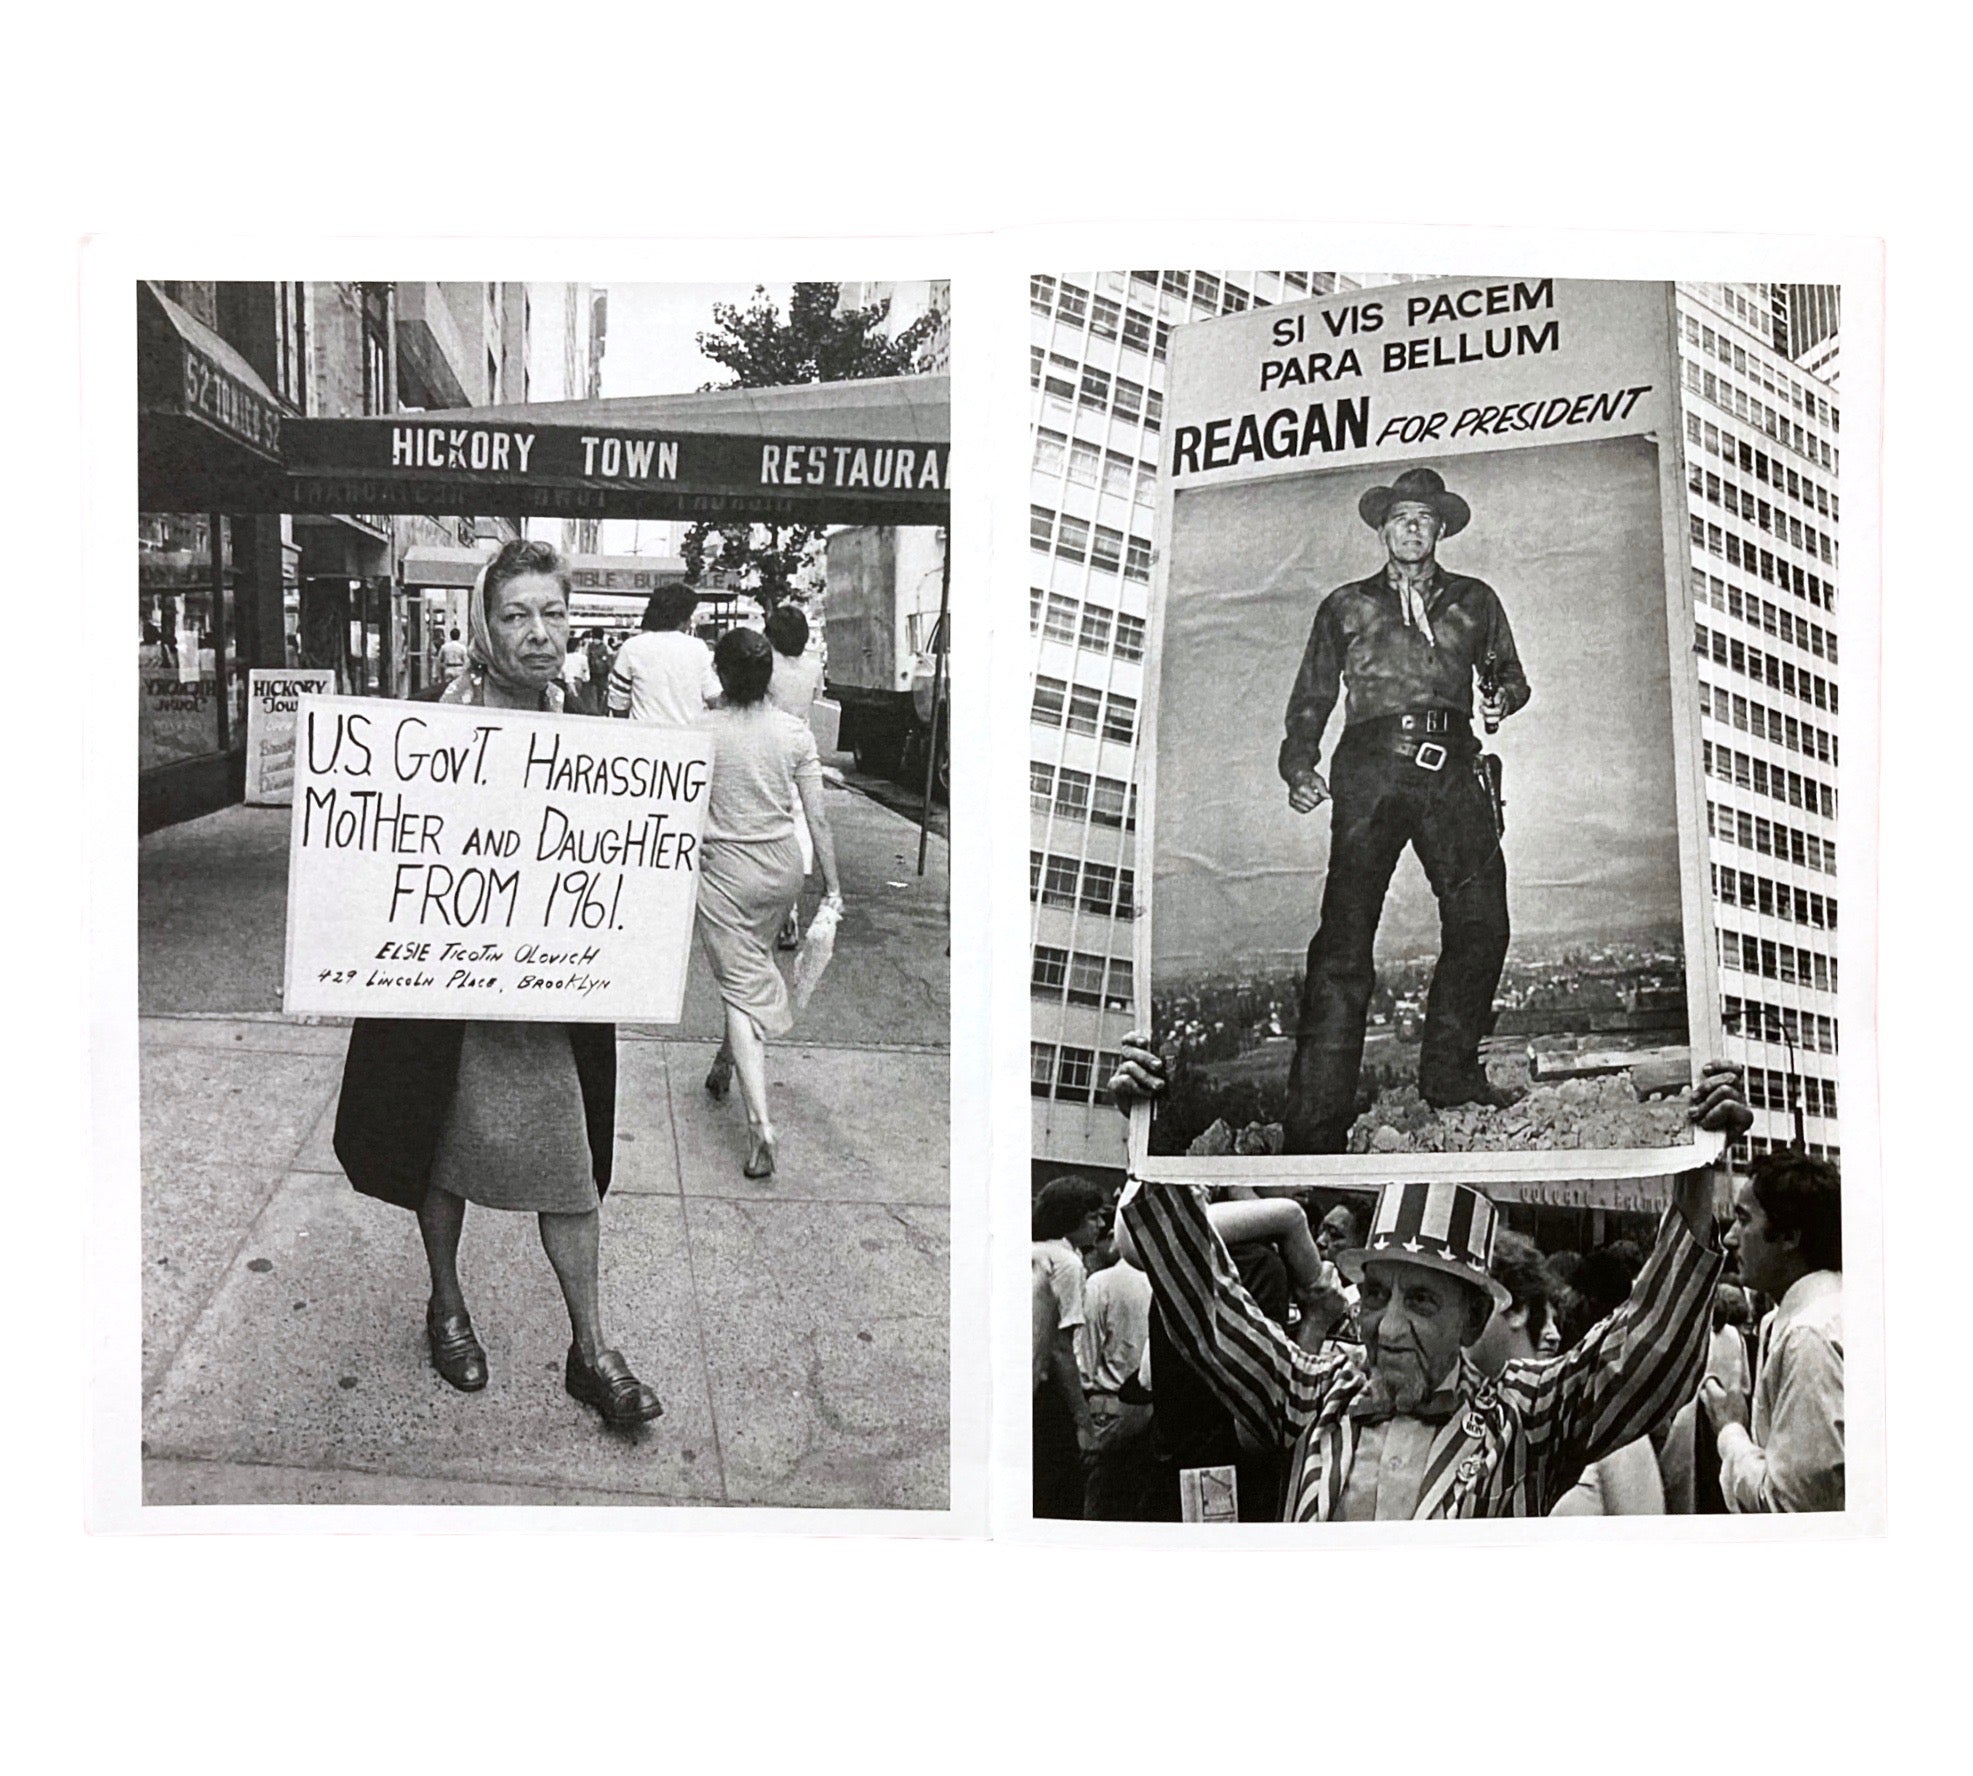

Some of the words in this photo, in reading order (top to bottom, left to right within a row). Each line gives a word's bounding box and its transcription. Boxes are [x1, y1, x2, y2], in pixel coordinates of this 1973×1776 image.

[1272, 314, 1305, 348] SI
[1322, 302, 1384, 338] VIS
[1407, 278, 1555, 327] PACEM
[1260, 348, 1363, 392] PARA
[1383, 320, 1559, 374] BELLUM
[392, 427, 536, 472] HICKORY
[581, 436, 679, 480] TOWN
[1171, 395, 1371, 477] REAGAN
[1375, 411, 1449, 447] FOR
[1450, 385, 1653, 438] PRESIDENT
[253, 680, 327, 697] HICKORY
[263, 698, 298, 713] Tow
[524, 732, 707, 802] HARASSING
[462, 827, 520, 858] AND
[536, 805, 697, 871] DAUGHTER
[389, 864, 519, 928] FROM
[544, 870, 625, 931] 1961.
[318, 968, 358, 984] 429
[375, 941, 431, 962] ELSIE
